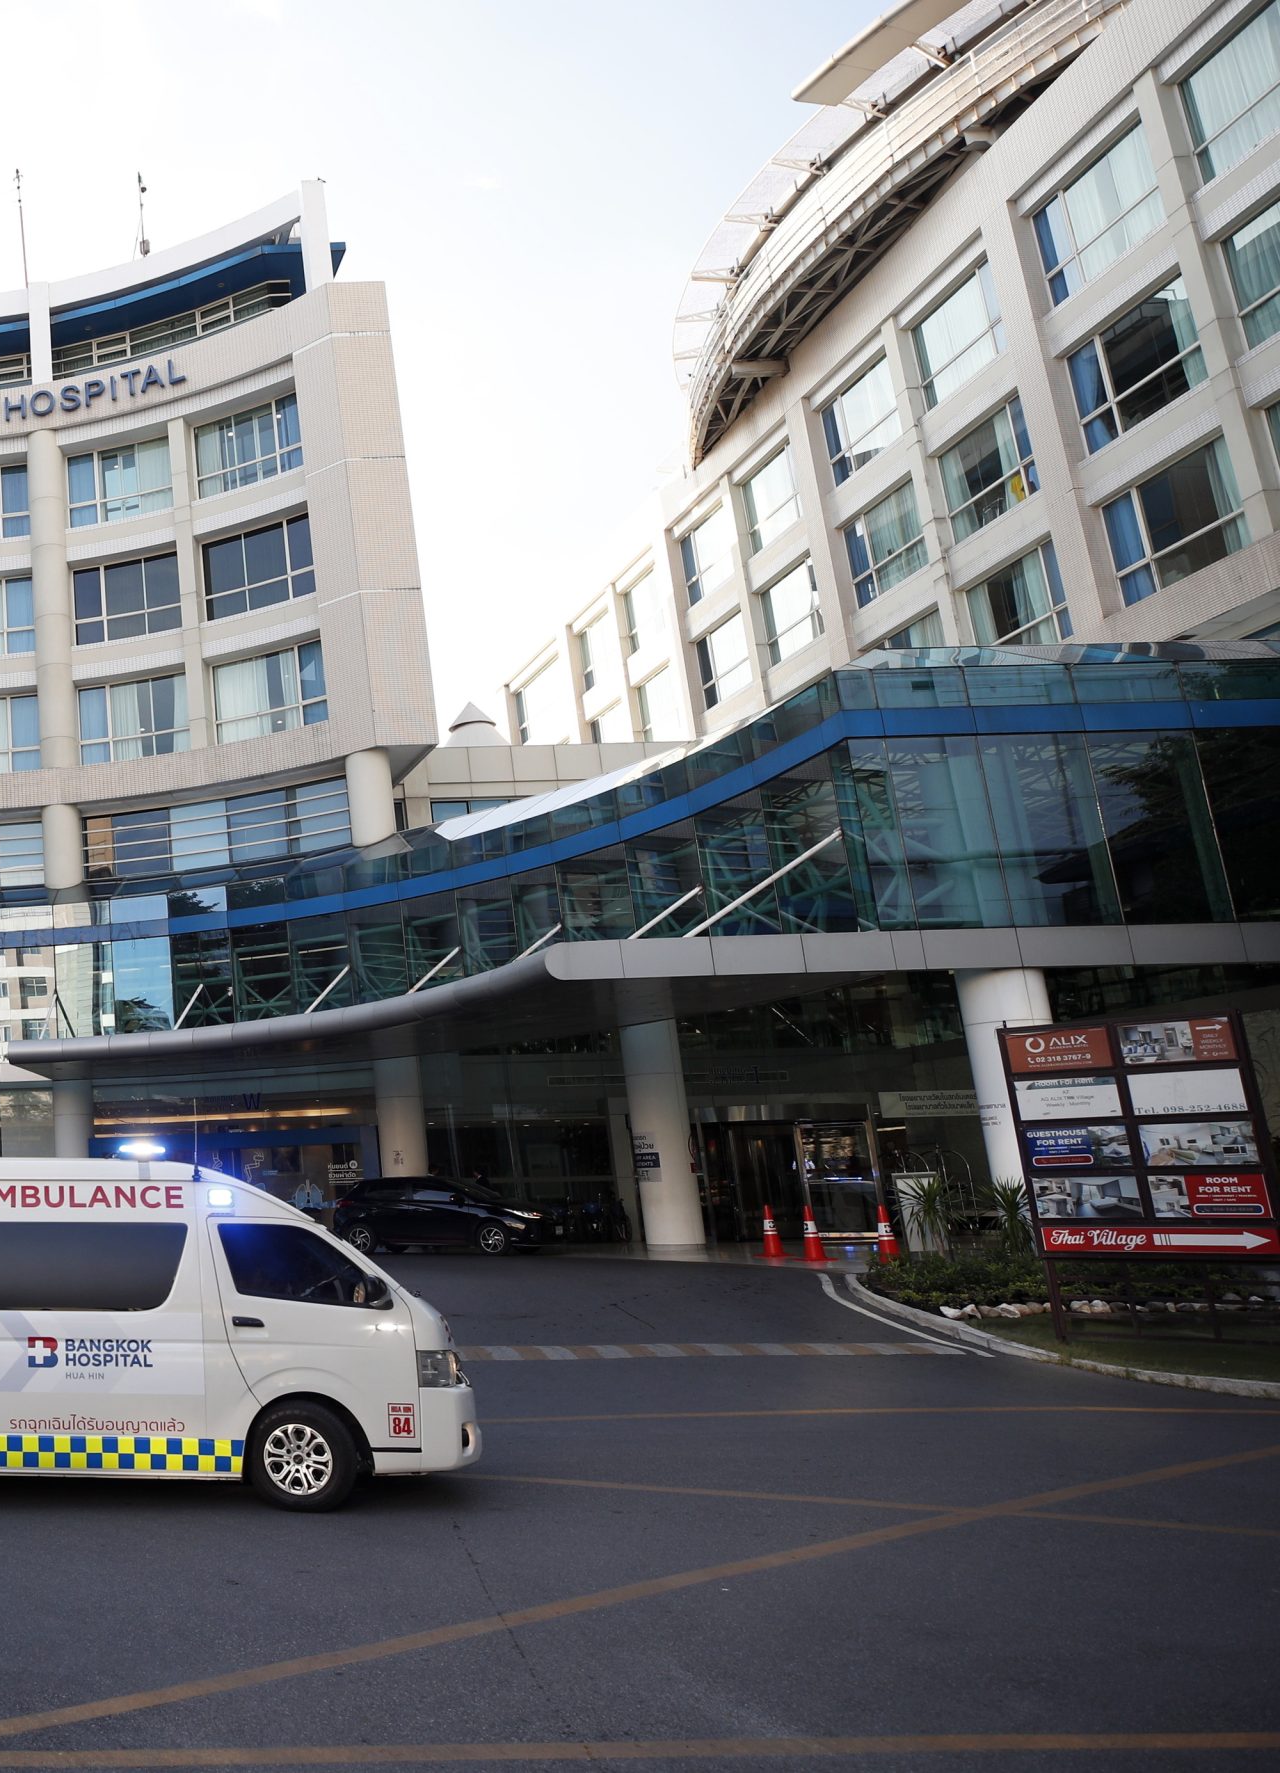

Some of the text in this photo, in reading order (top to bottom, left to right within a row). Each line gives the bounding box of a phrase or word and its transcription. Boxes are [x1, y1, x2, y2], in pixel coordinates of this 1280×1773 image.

[4, 359, 187, 422] HOSPITAL
[1049, 1034, 1088, 1047] ALIX
[1047, 1054, 1062, 1062] 318
[1034, 1079, 1059, 1087] Room
[1134, 1103, 1246, 1115] Tel. 098-252-4688
[1026, 1129, 1088, 1138] GUESTHOUSE
[1223, 1185, 1252, 1193] RENT
[1050, 1229, 1147, 1251] Thai Village
[65, 1338, 153, 1353] BANGKOK
[65, 1353, 153, 1368] HOSPITAL
[65, 1372, 105, 1380] HUA HIN
[9, 1413, 186, 1435] รถฉุกเฉินได้รับอนุญาตแล้ว
[392, 1417, 413, 1435] 84
